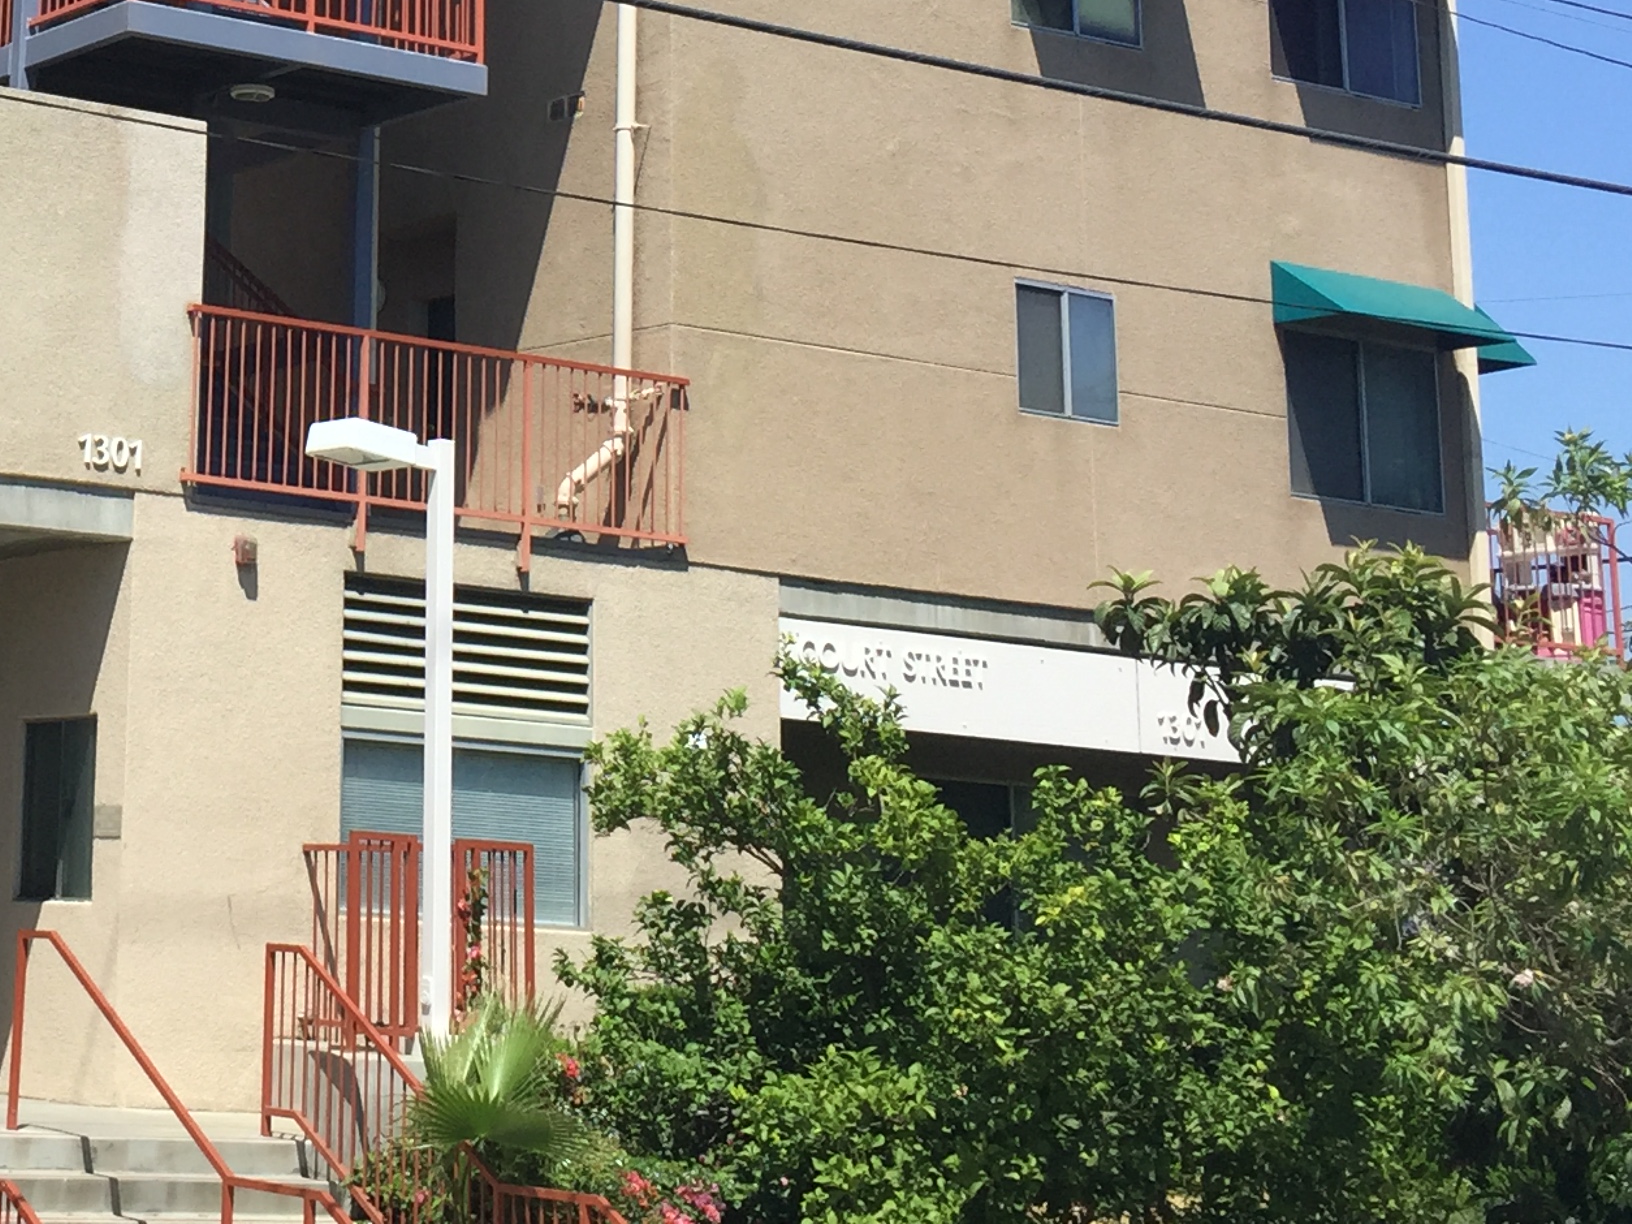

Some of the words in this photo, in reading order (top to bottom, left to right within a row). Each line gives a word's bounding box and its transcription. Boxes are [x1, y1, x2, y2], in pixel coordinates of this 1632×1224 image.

[78, 433, 143, 470] 1301
[900, 649, 989, 690] STREET
[1156, 713, 1205, 749] 1301
